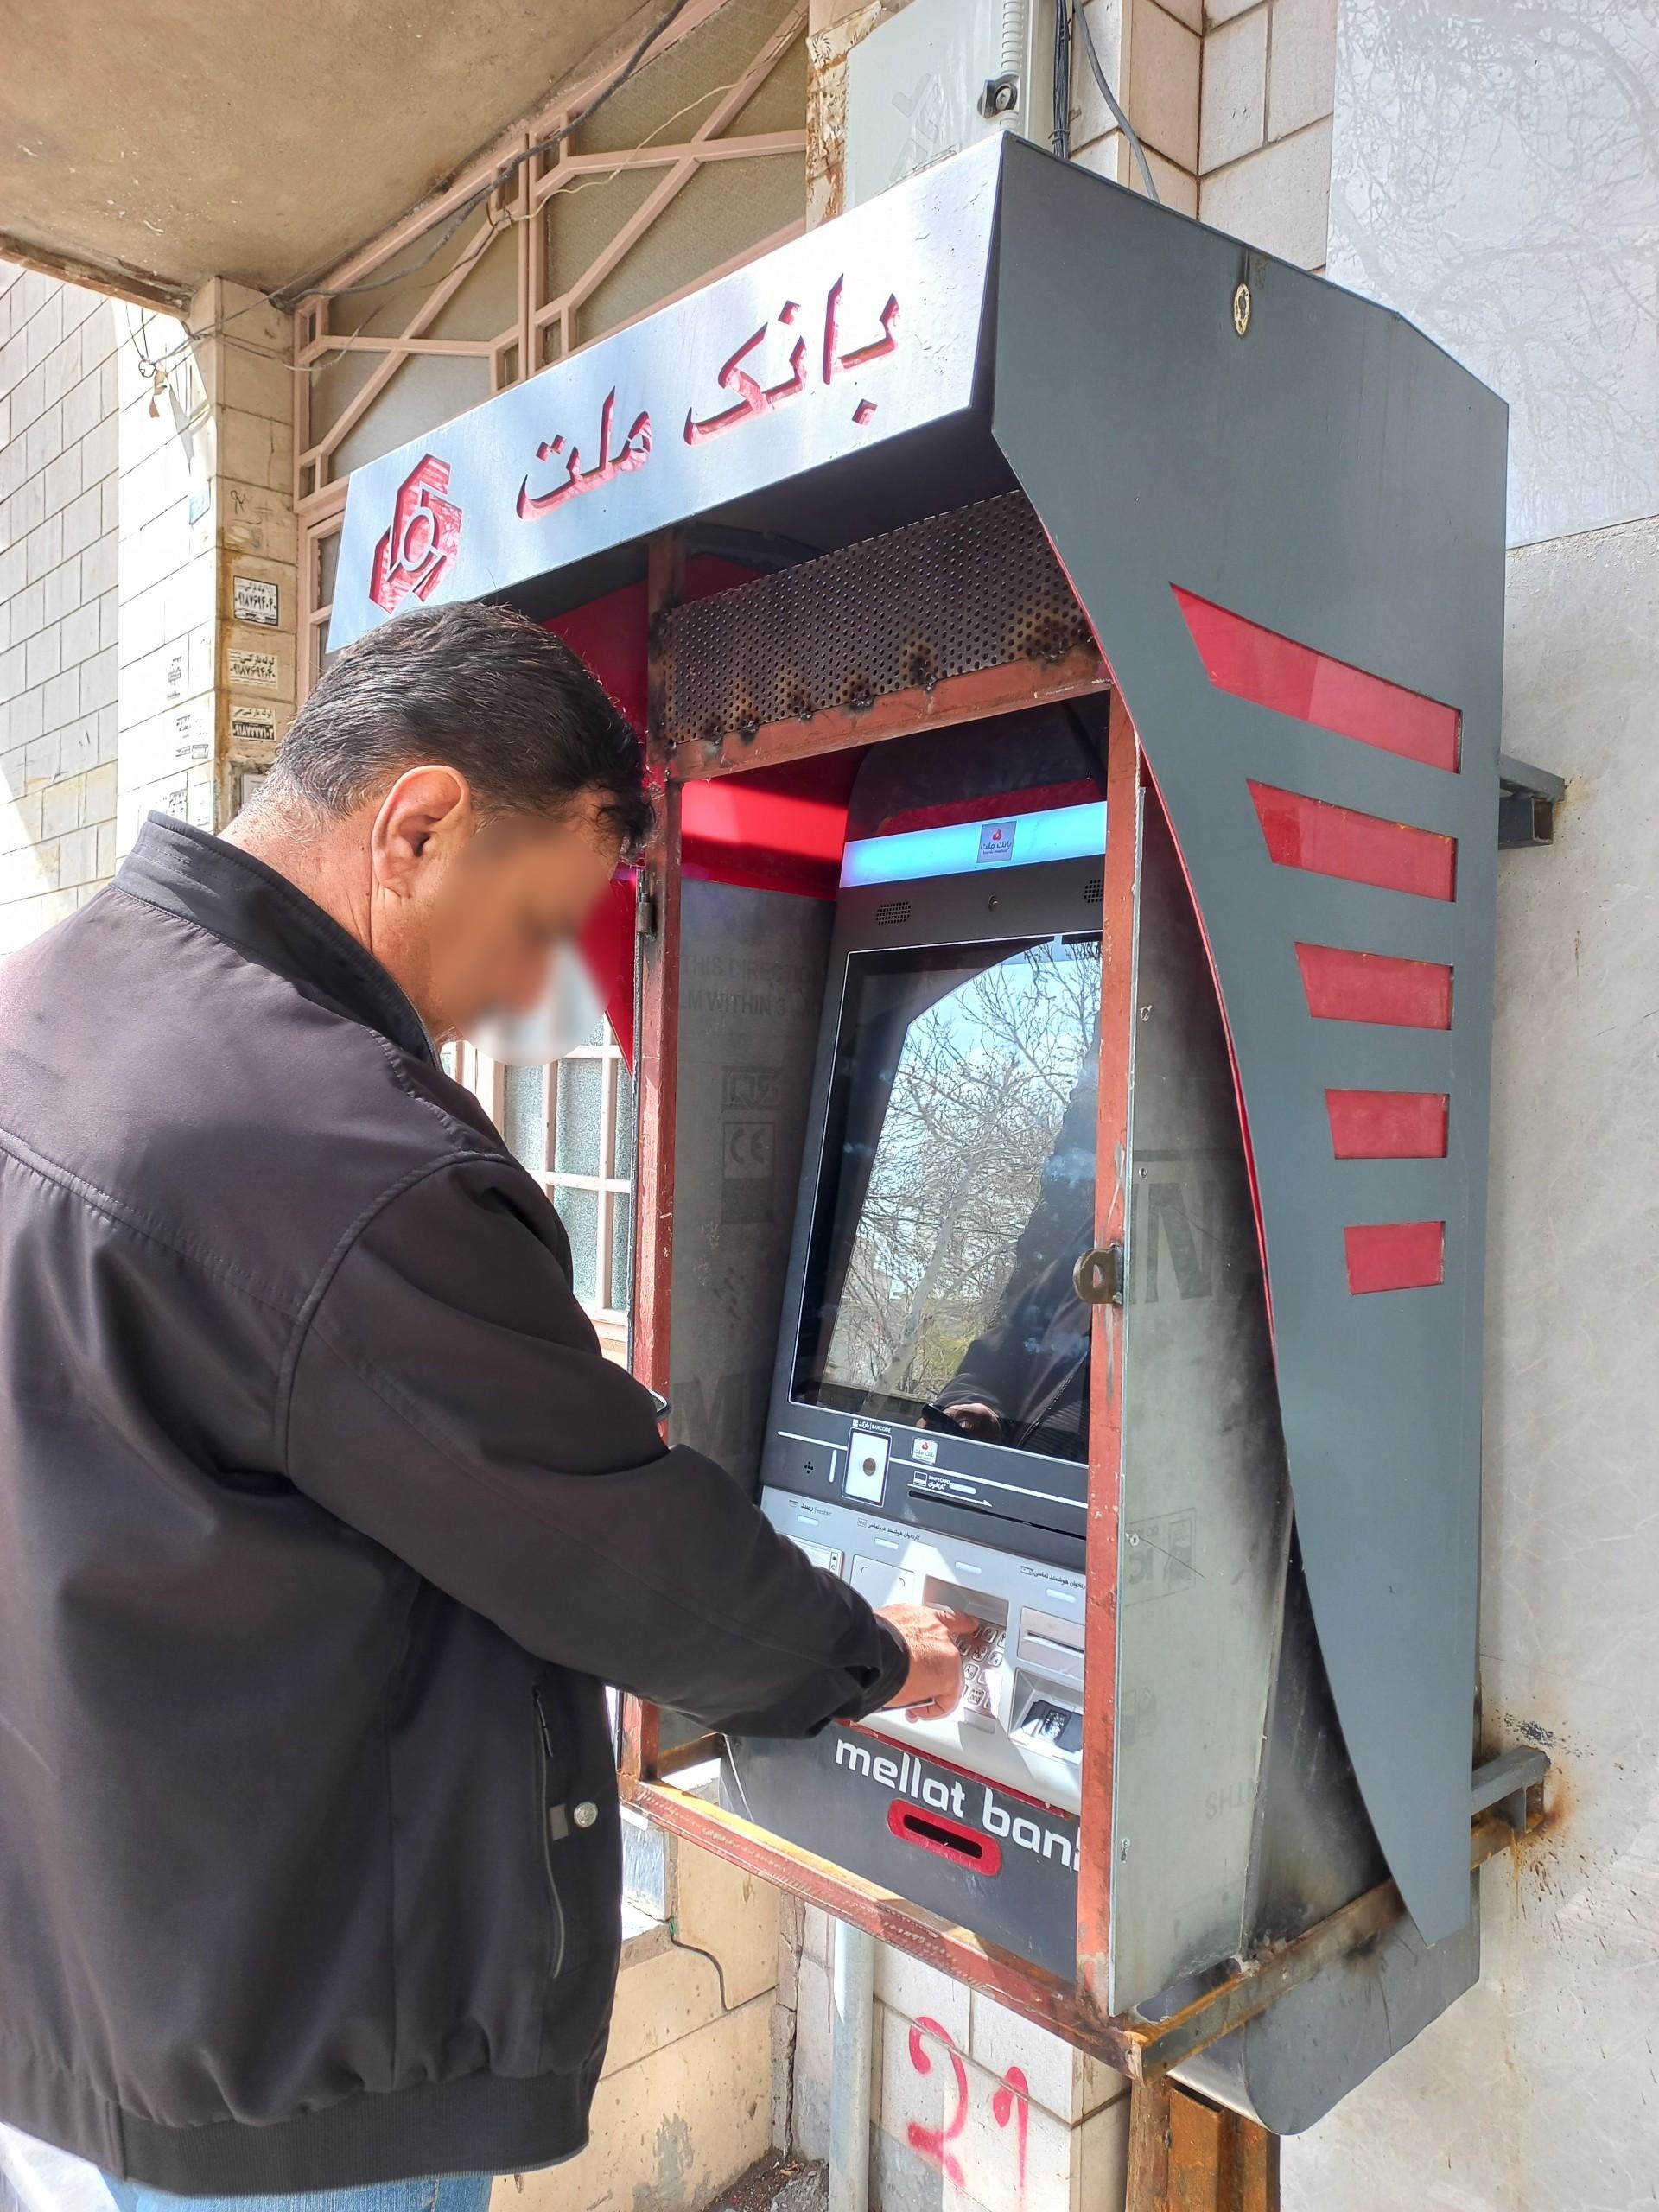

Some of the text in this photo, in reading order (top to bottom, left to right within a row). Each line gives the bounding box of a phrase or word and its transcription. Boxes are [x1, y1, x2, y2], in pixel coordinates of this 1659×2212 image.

[516, 273, 901, 521] بانک ملت
[730, 957, 819, 986] DIRECTIO
[800, 1503, 814, 1512] رسید
[835, 1738, 1081, 1872] mellat ban
